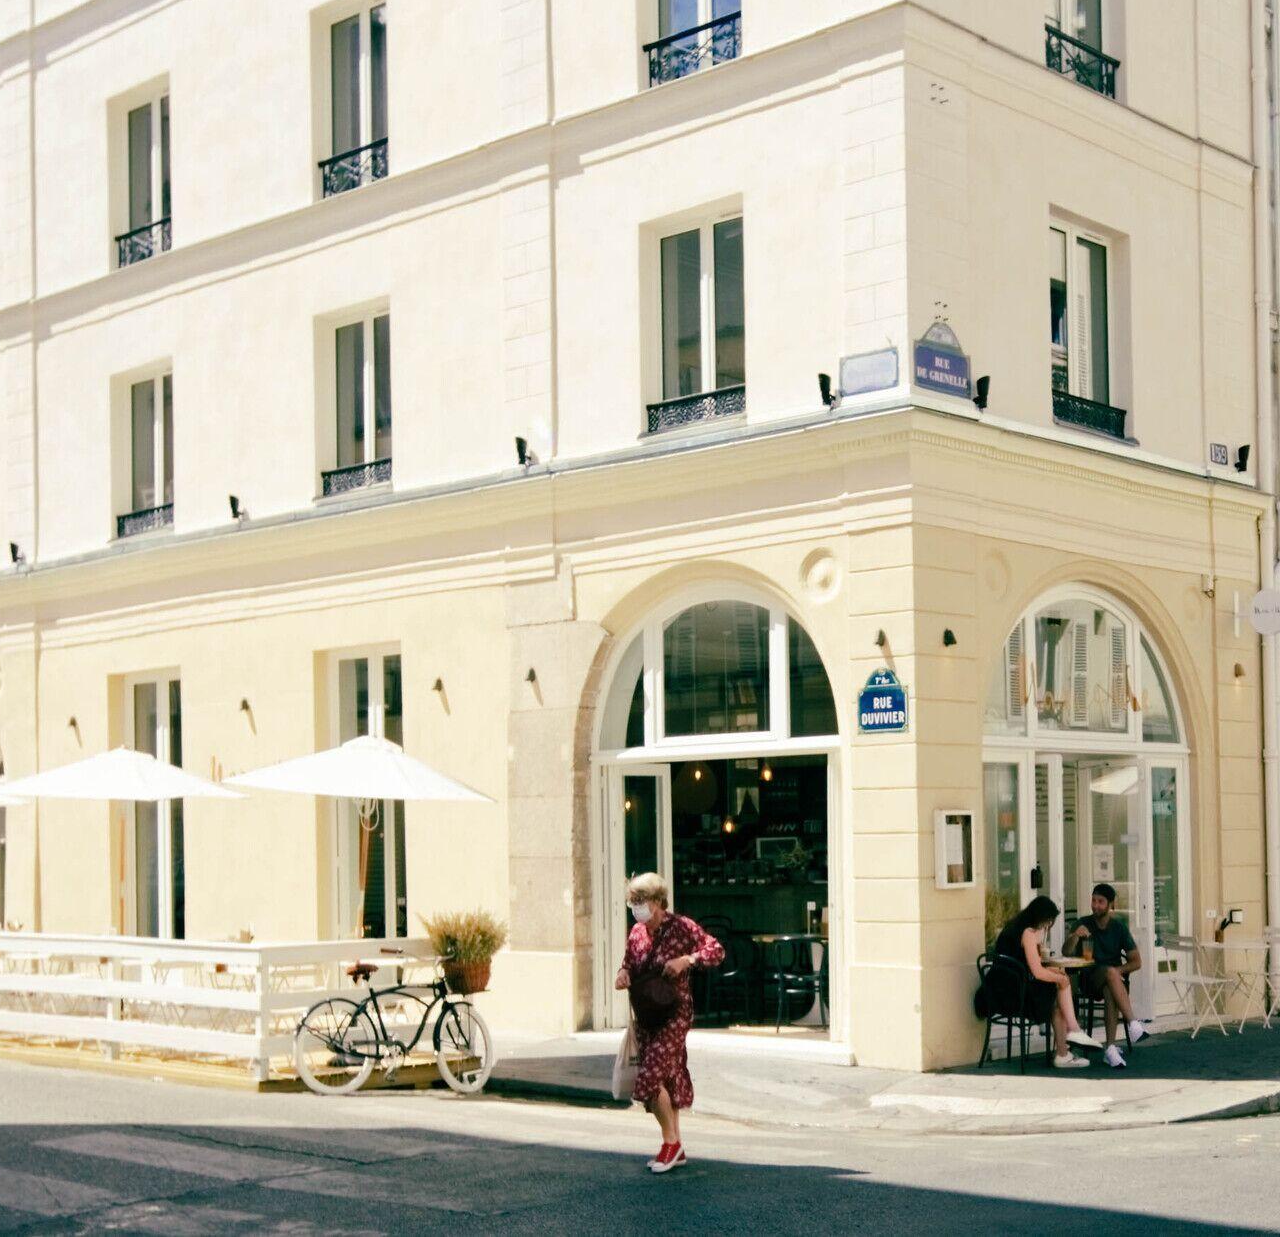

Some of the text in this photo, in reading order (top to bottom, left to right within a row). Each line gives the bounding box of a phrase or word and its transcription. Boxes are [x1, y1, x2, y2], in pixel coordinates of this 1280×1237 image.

[934, 356, 950, 370] RUE
[916, 365, 969, 389] DE GRENELLE
[873, 696, 893, 709] RUE
[861, 710, 905, 726] DUVIVIER
